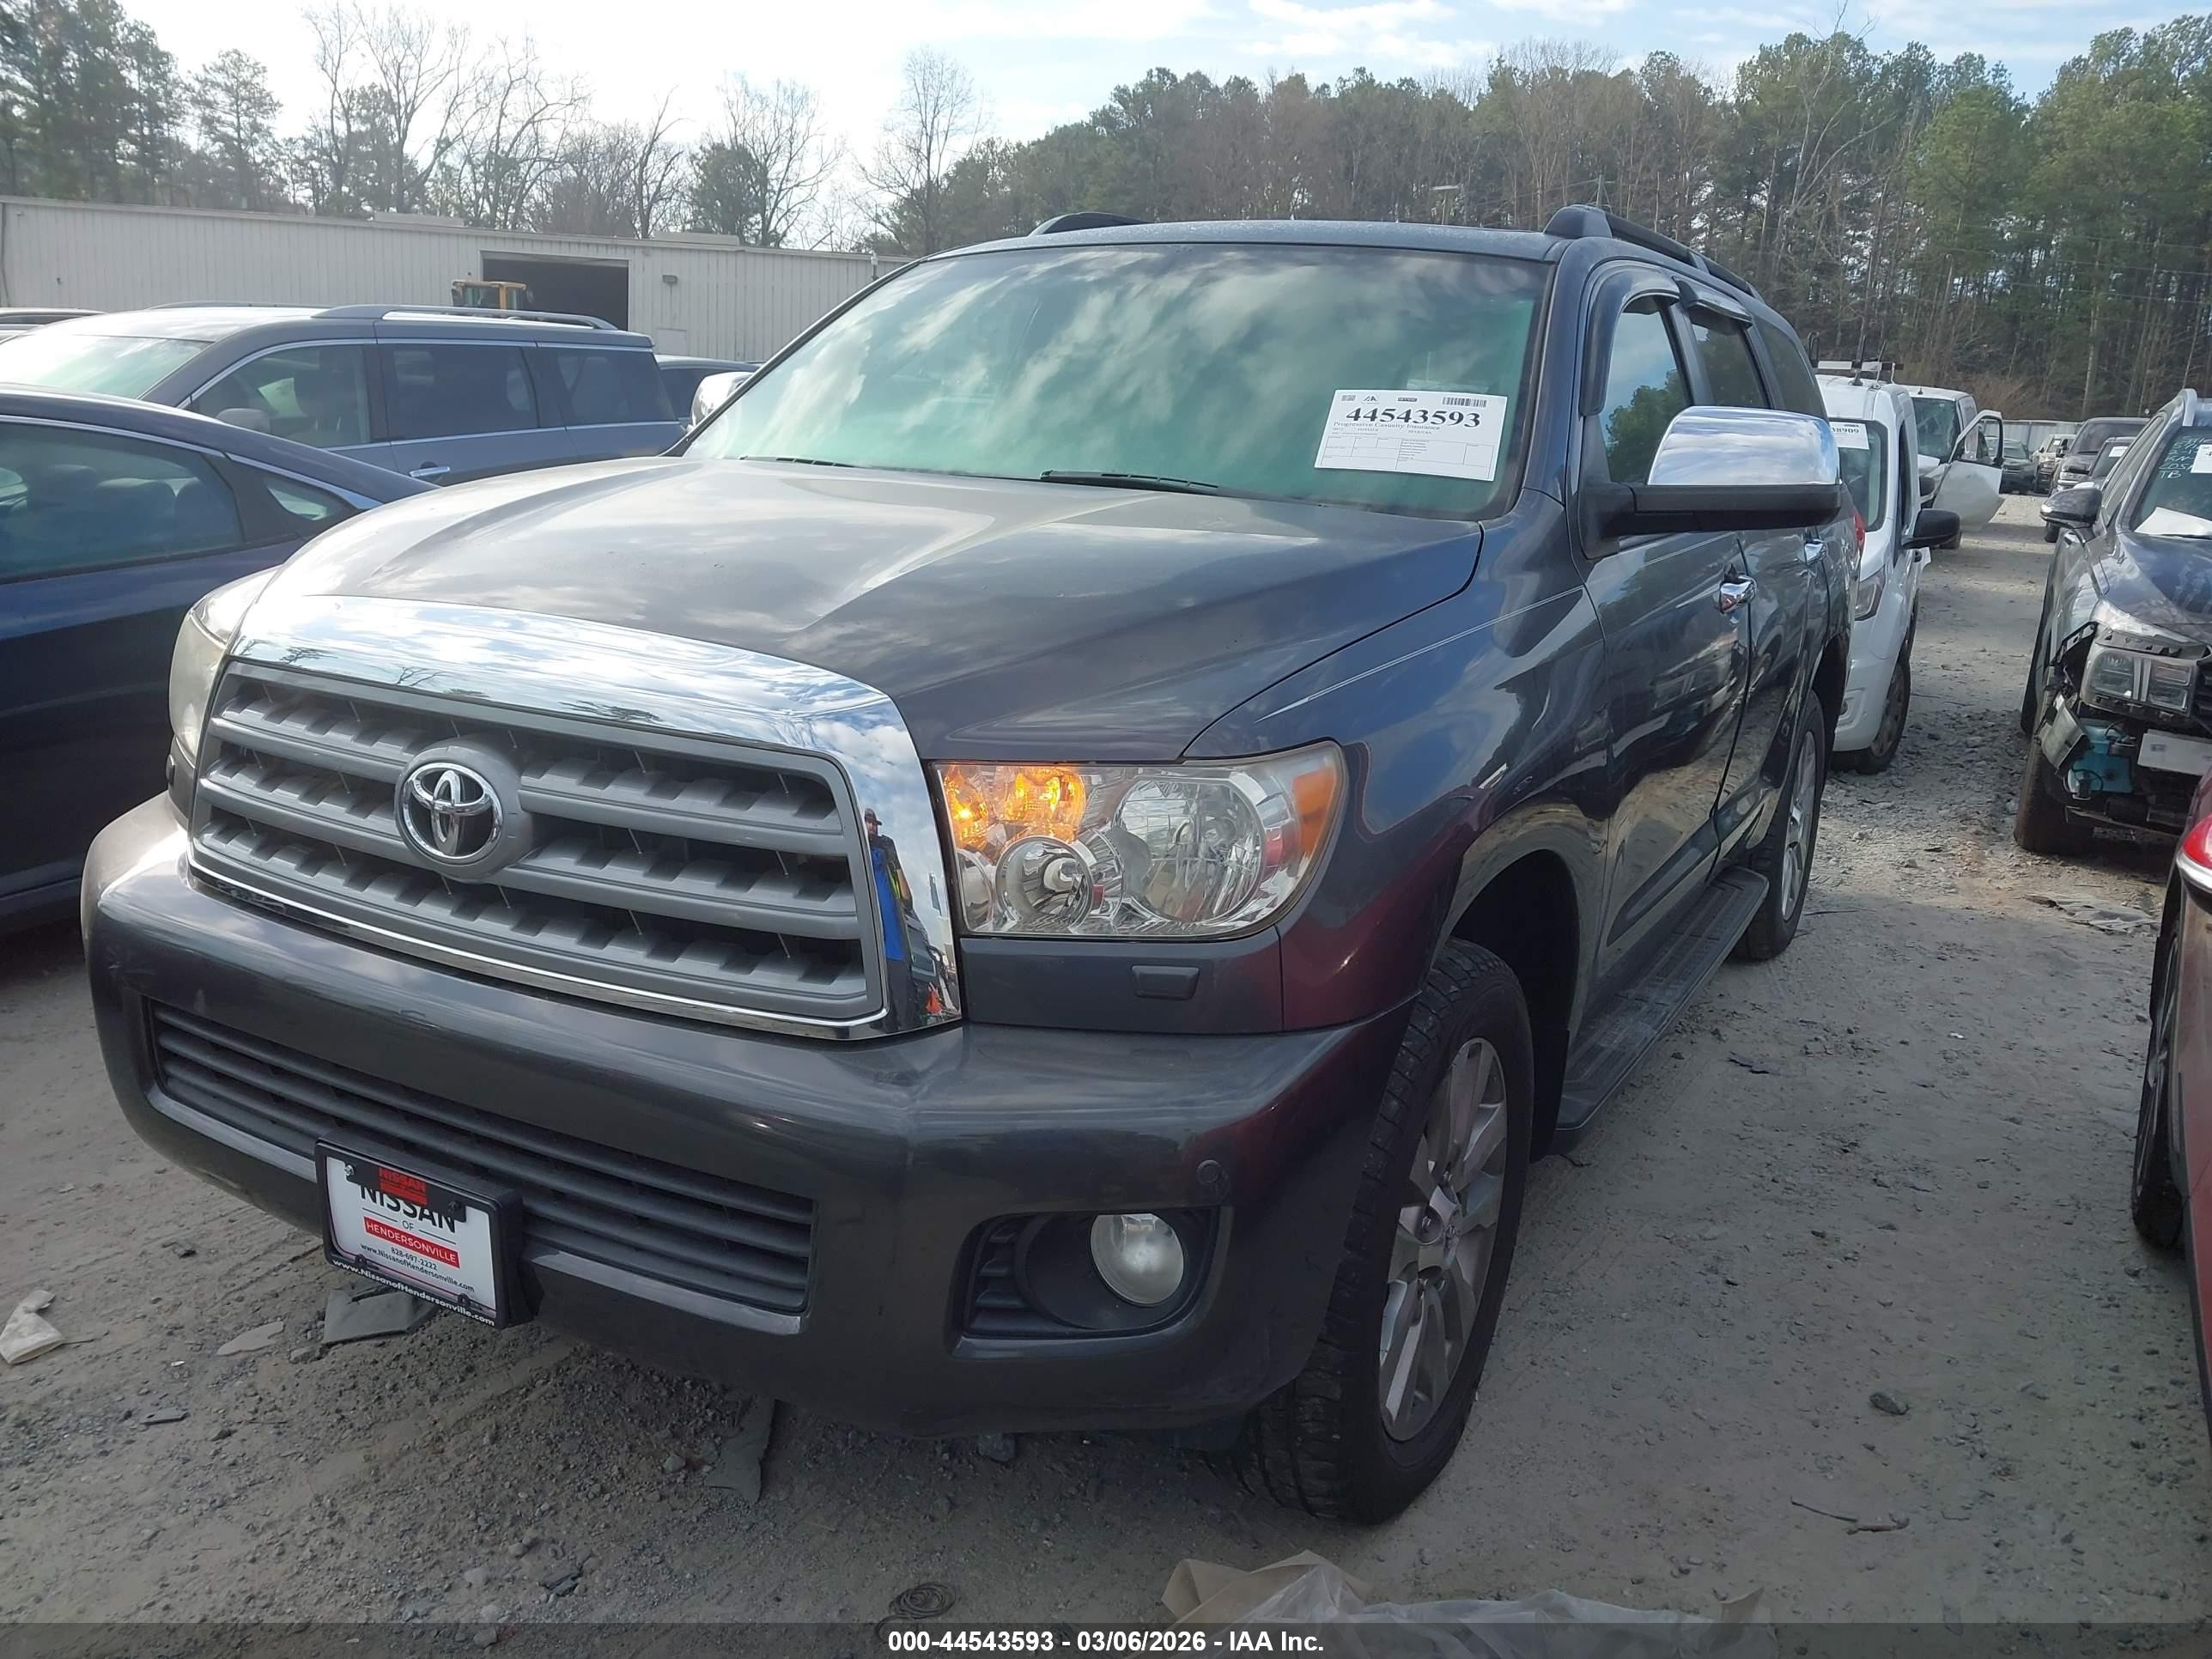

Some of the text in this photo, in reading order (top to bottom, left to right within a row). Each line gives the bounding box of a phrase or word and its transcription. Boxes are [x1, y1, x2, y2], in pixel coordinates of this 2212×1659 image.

[1346, 407, 1480, 428] 44543593
[402, 1220, 414, 1231] OF
[367, 1221, 457, 1263] HENDERSONVILLE
[361, 1243, 475, 1292] www.NissanofHendersonville.com
[391, 1247, 438, 1270] 828-697-2222
[332, 1260, 495, 1327] www.NissanofHendersonville.com
